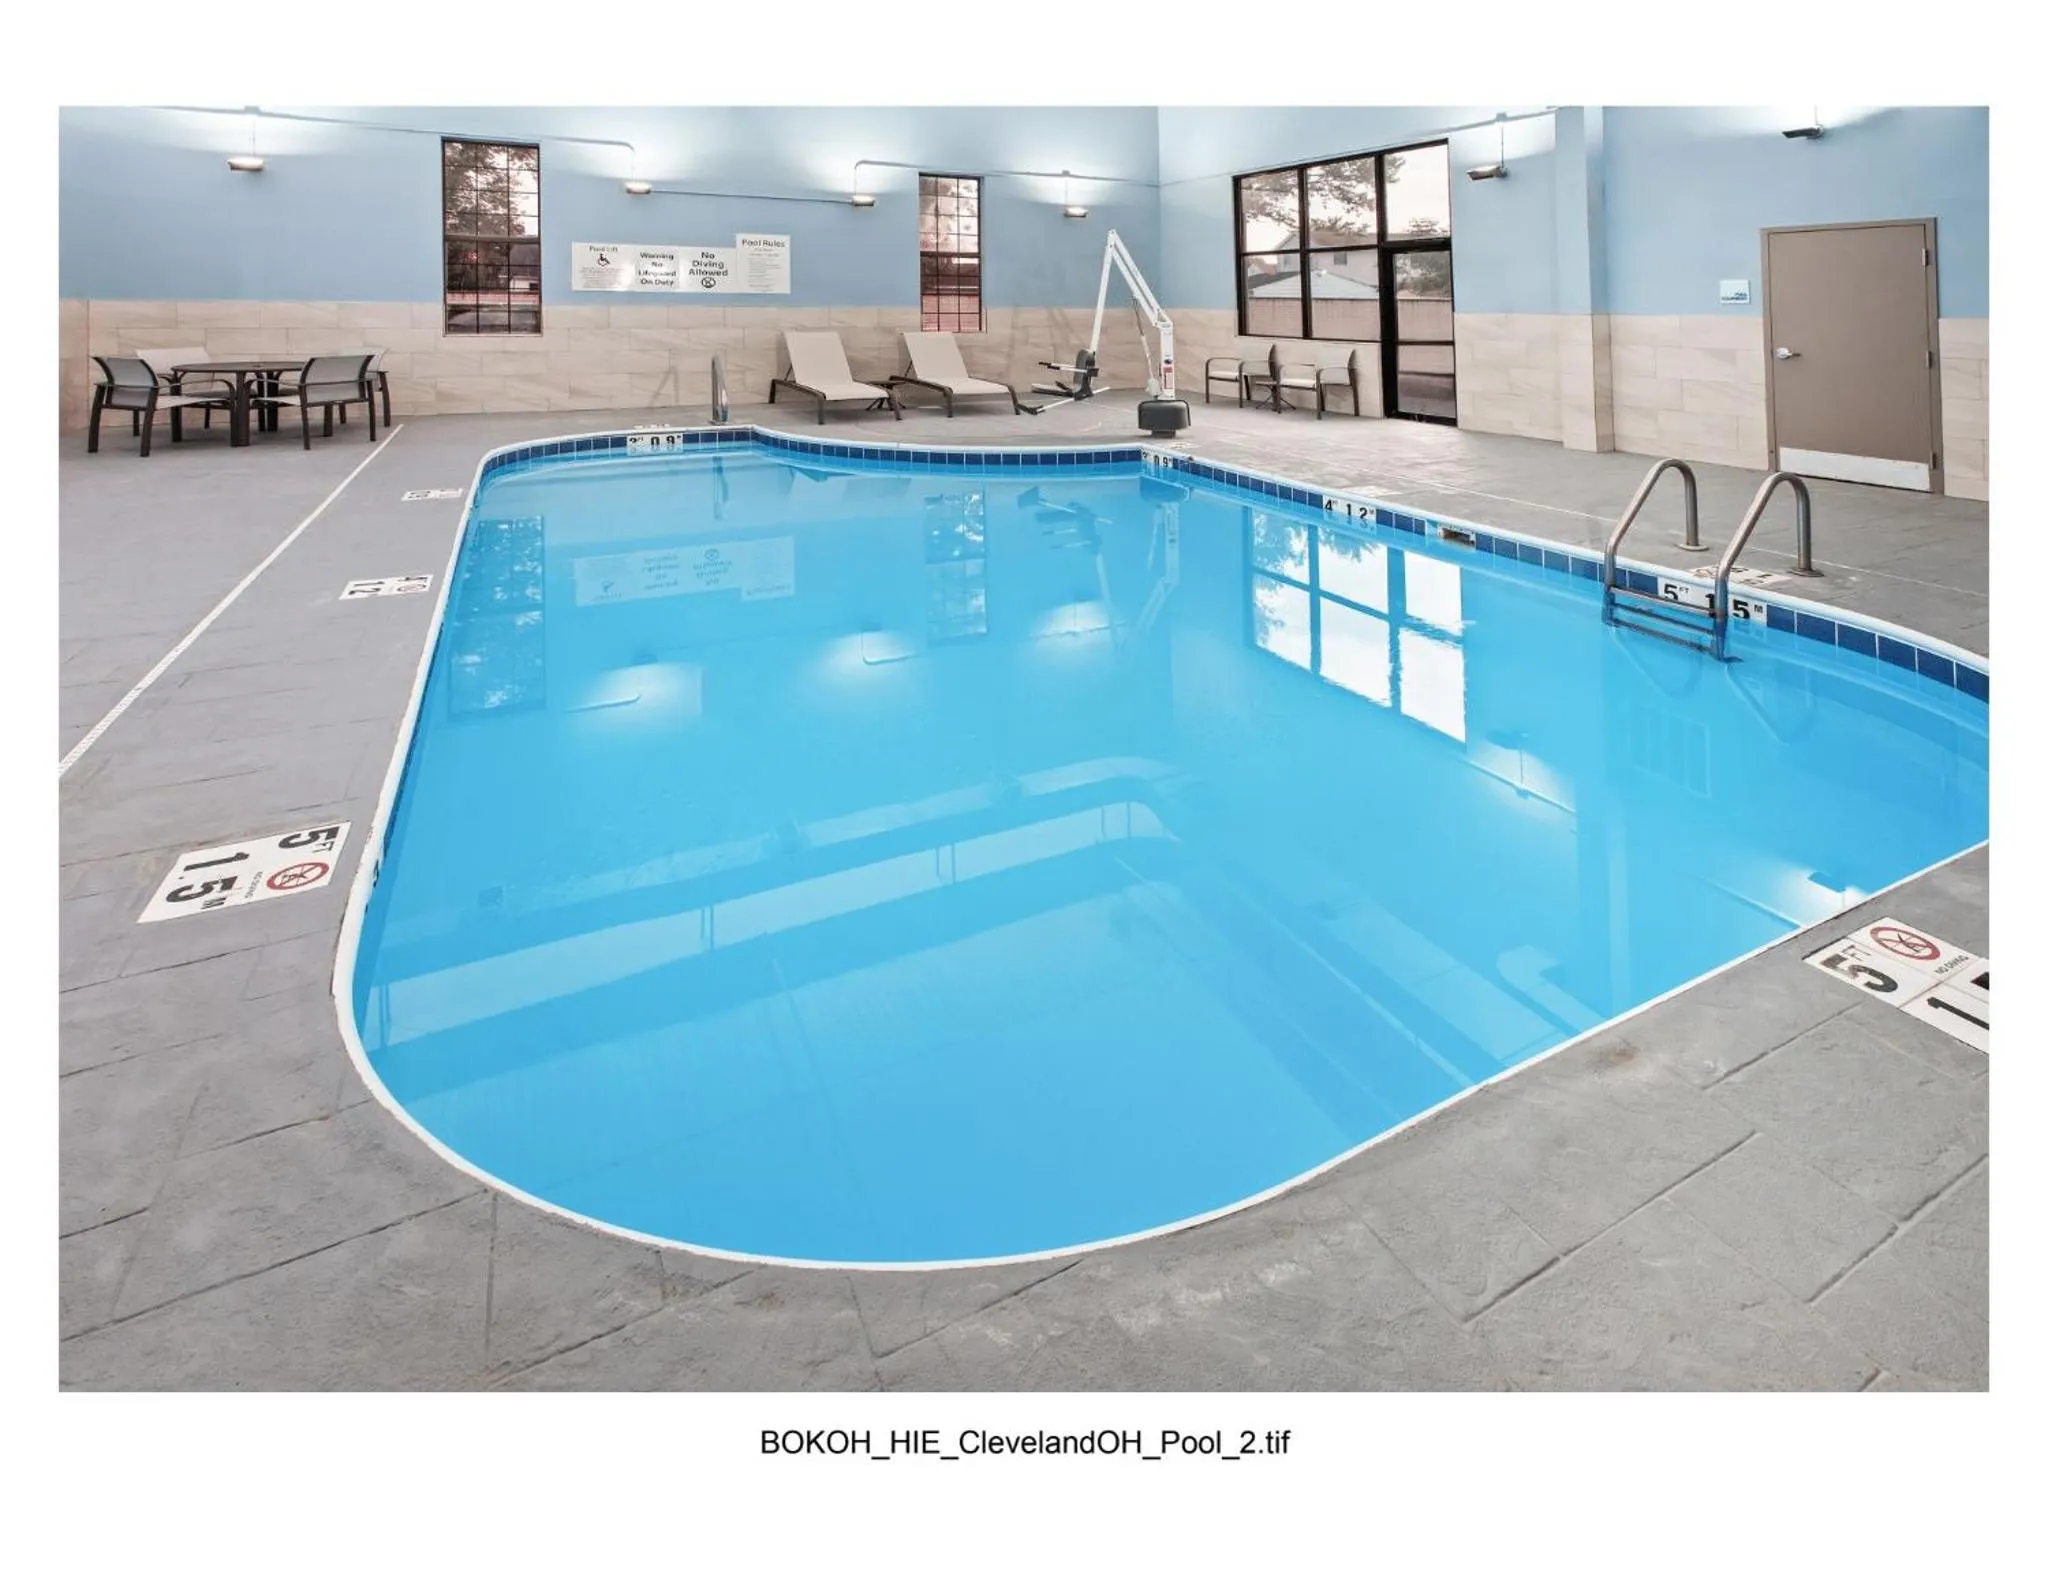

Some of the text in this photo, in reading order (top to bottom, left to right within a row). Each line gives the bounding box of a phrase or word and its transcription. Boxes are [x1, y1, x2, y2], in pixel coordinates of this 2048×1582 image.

[742, 239, 761, 247] Pool
[640, 252, 674, 260] Warning
[692, 260, 724, 269] Diving
[689, 268, 728, 276] Allowed
[654, 279, 674, 287] Duty
